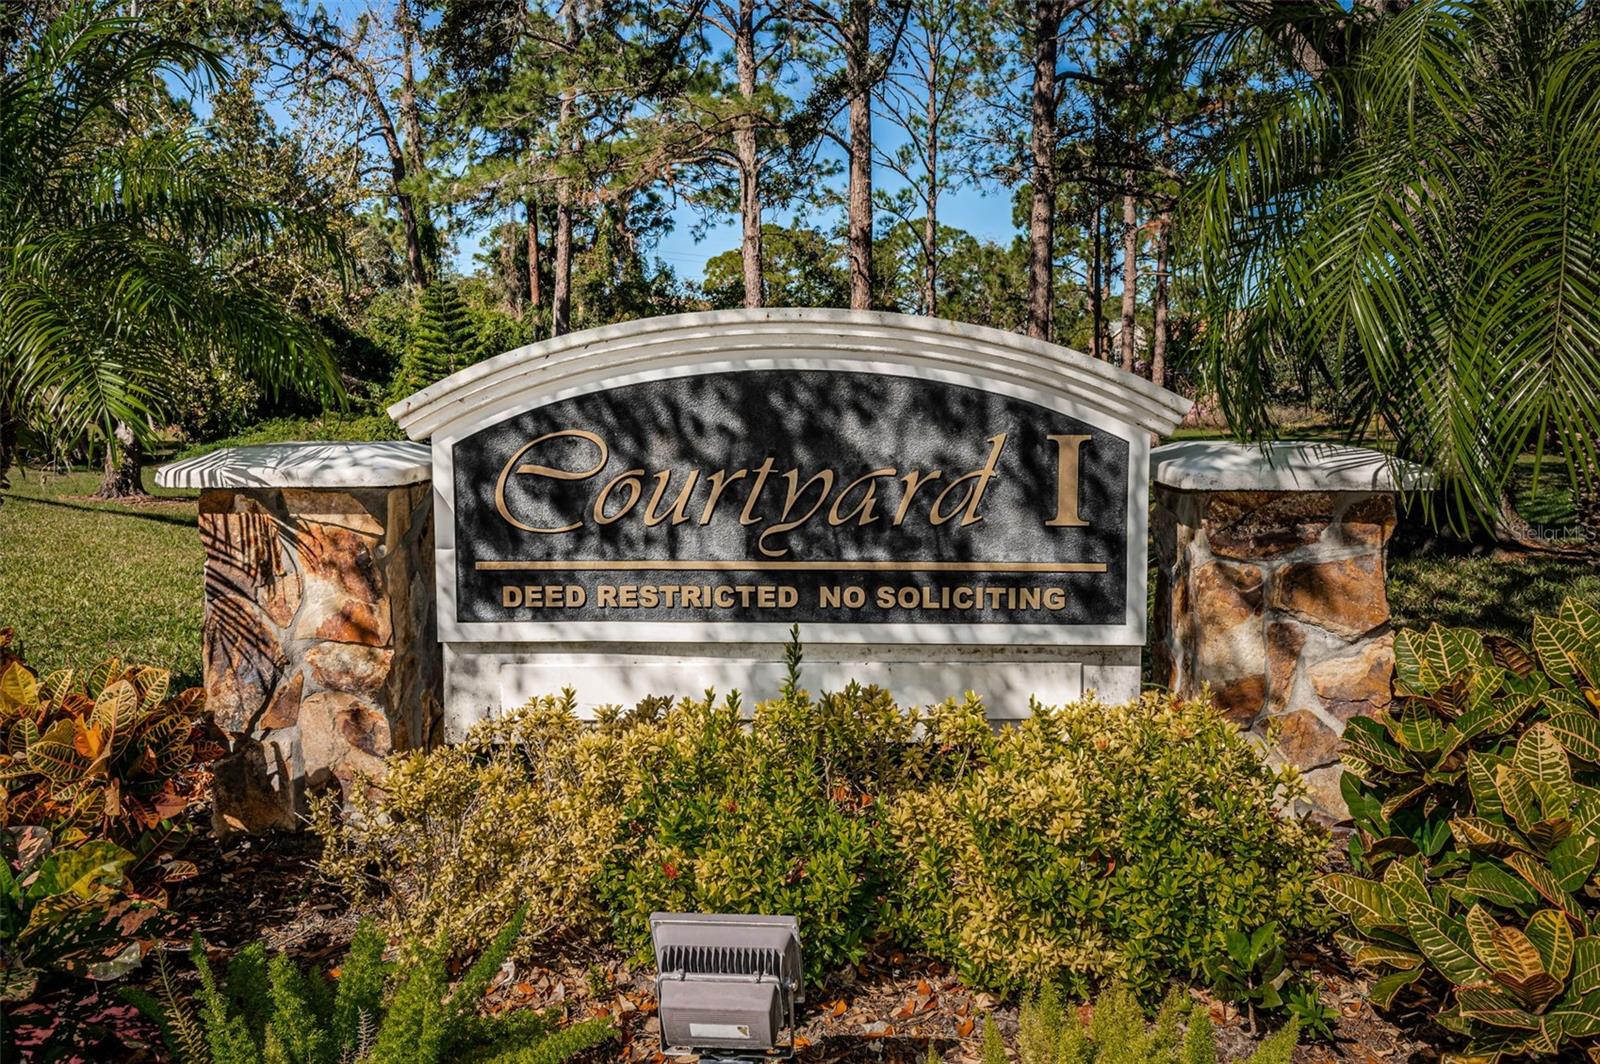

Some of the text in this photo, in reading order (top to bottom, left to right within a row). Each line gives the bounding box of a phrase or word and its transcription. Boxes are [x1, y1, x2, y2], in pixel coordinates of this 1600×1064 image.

[495, 430, 1092, 557] Courtyard I
[502, 585, 1067, 611] DEED RESTRICTED NO SOLICITING
